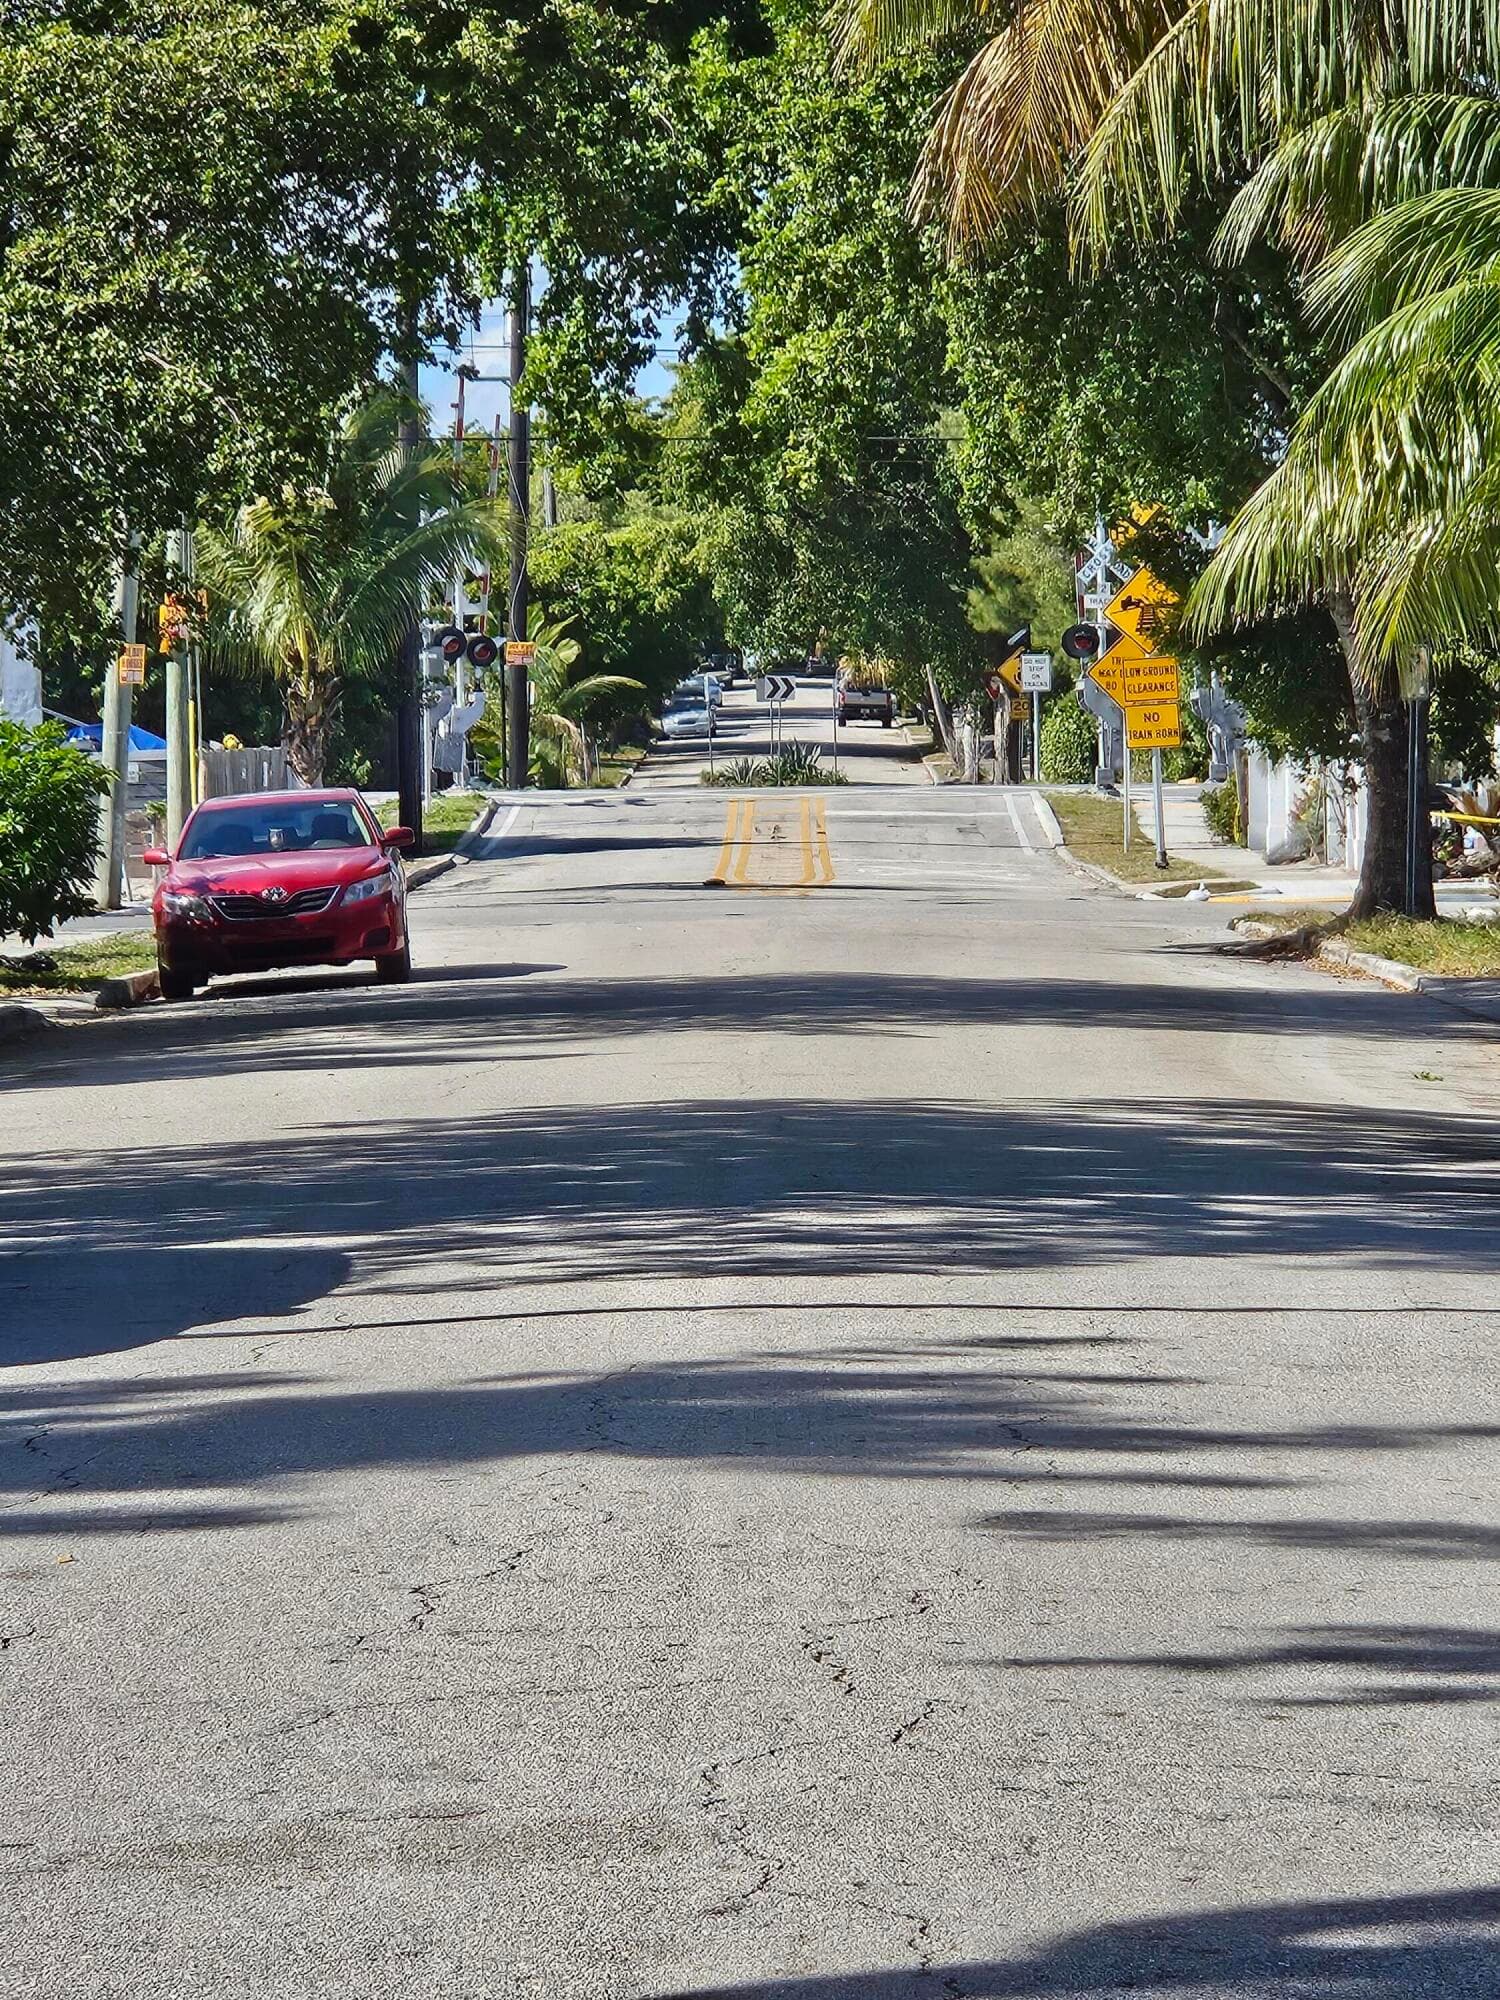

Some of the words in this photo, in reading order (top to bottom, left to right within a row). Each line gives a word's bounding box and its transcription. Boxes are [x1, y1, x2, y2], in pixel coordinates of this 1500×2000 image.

[1126, 667, 1141, 679] LOW
[1143, 665, 1175, 677] GROUND
[1127, 681, 1175, 694] CLEARANCE
[1143, 712, 1160, 723] NO
[1129, 729, 1153, 740] TRAIN
[1156, 728, 1179, 738] HORN
